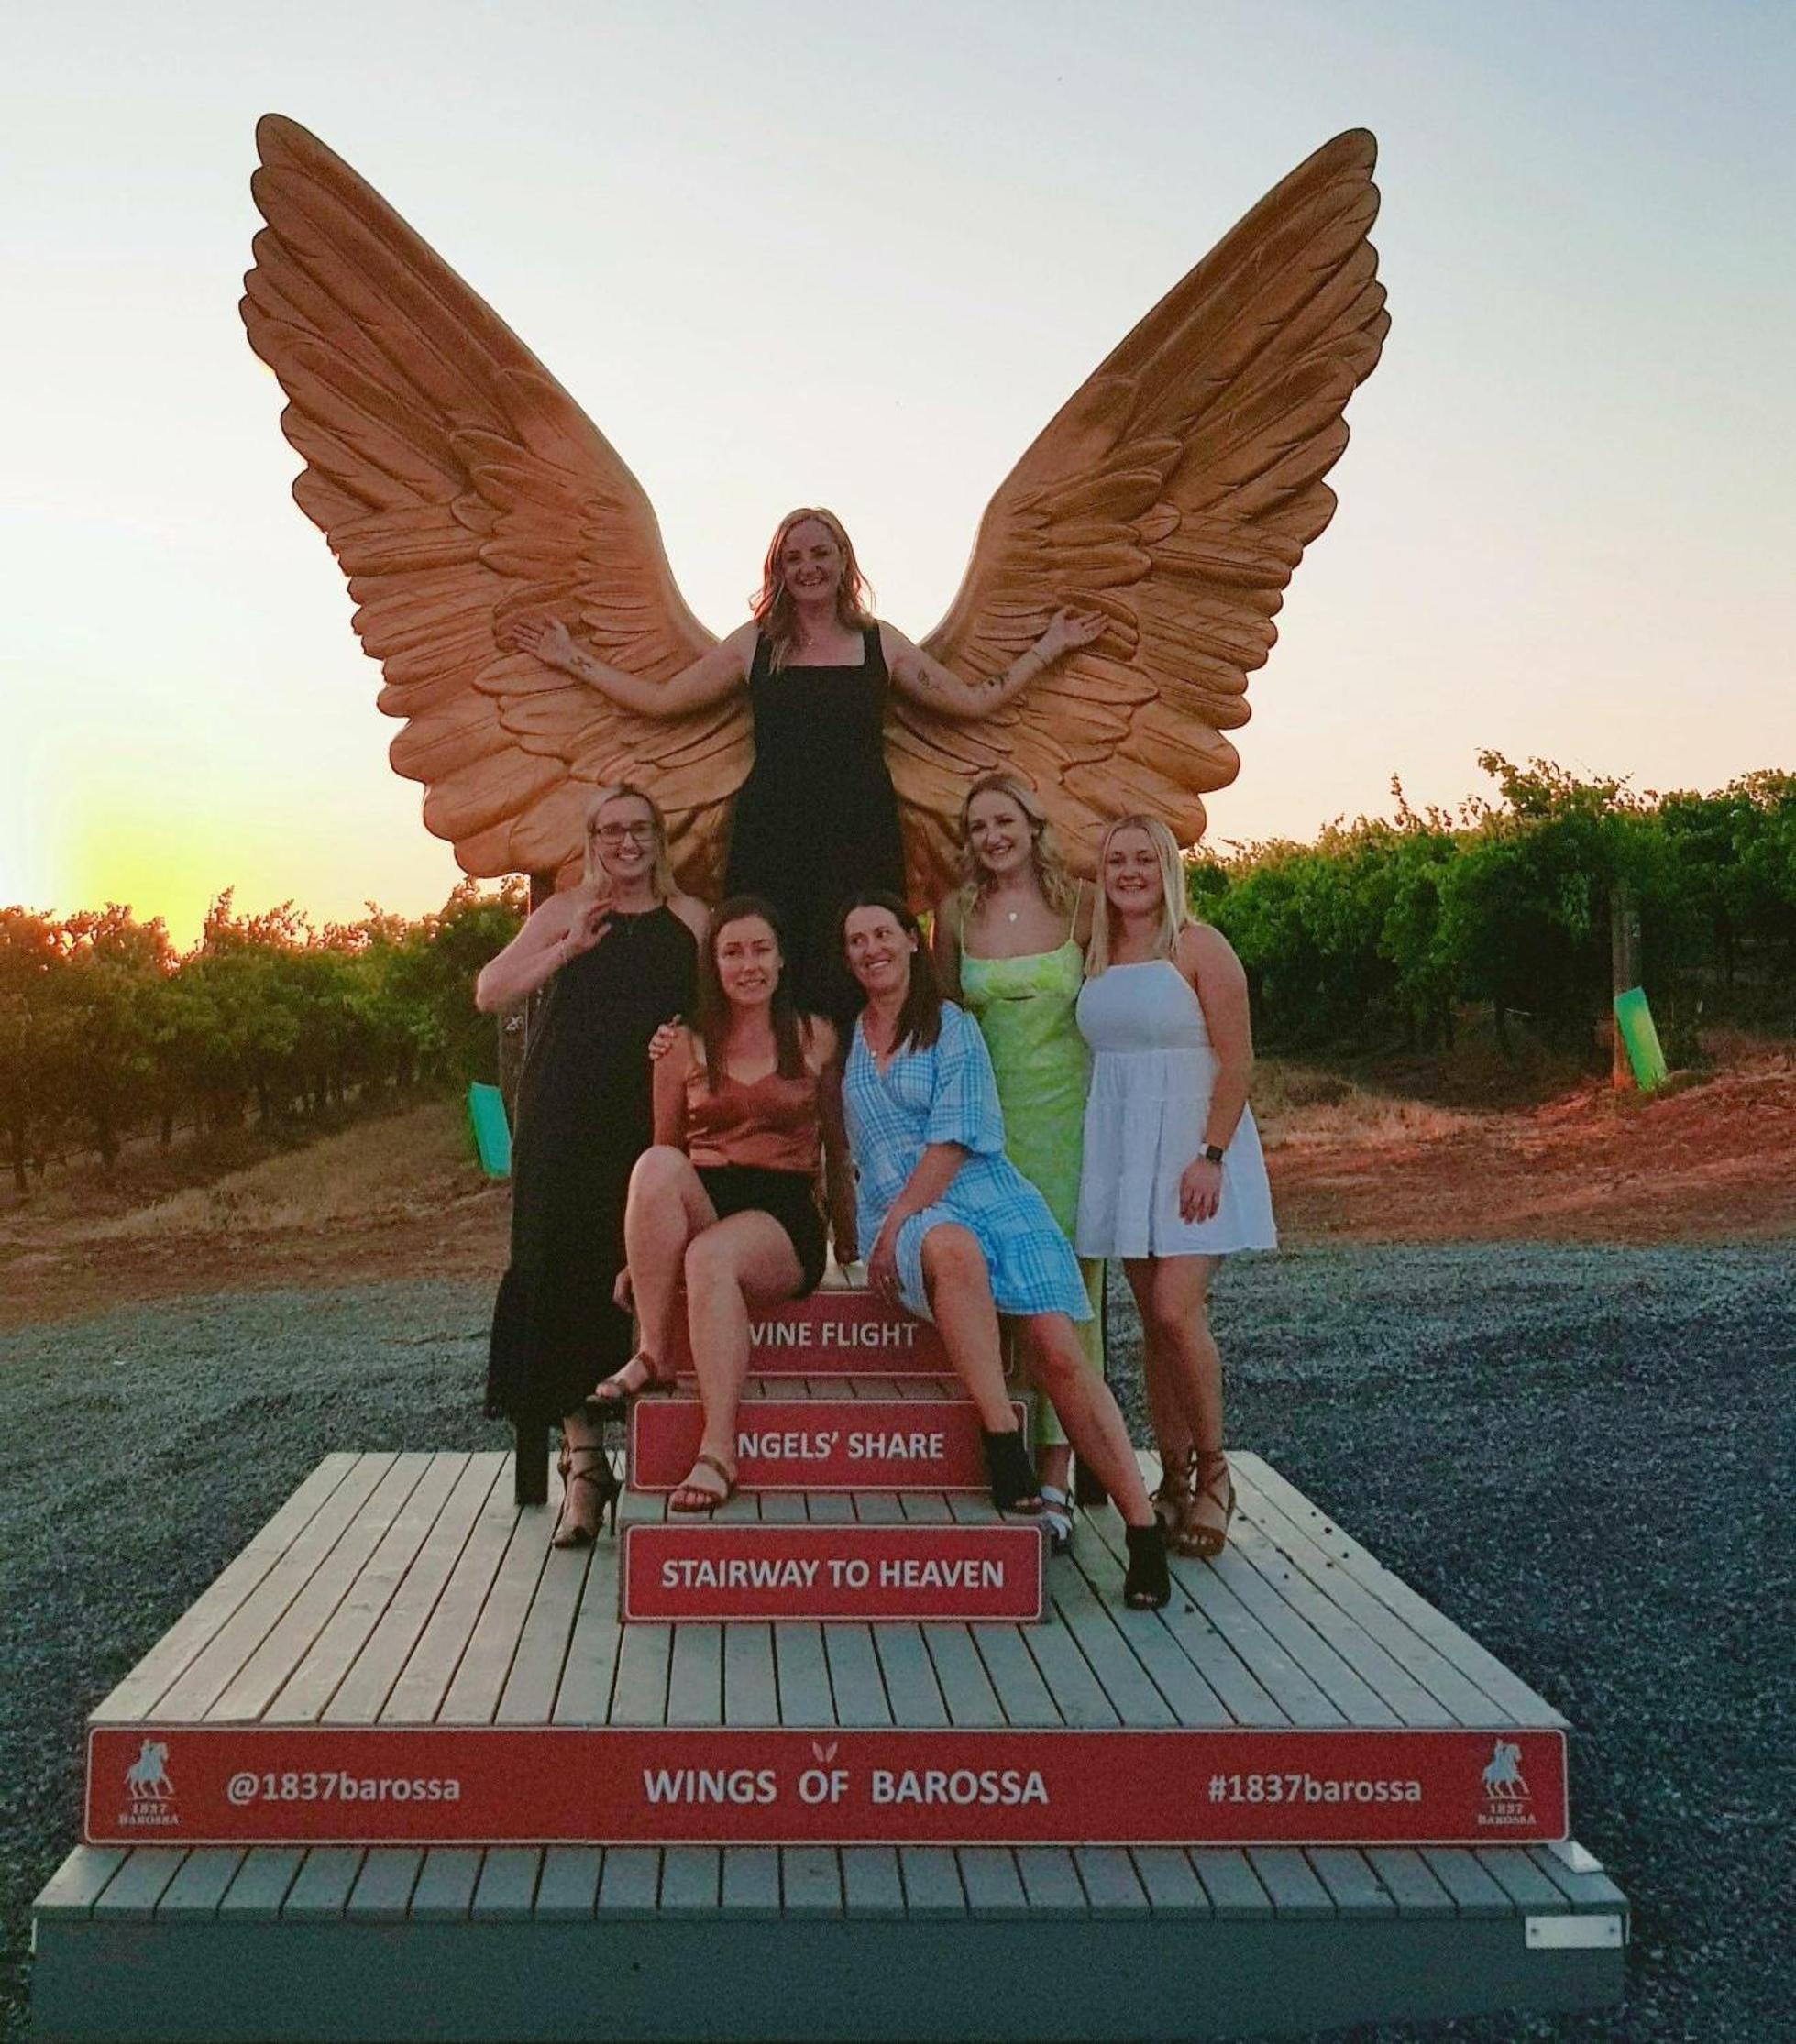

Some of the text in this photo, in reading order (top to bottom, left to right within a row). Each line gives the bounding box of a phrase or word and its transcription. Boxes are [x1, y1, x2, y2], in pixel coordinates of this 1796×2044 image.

[750, 1322, 918, 1347] VINE FLIGHT
[737, 1431, 943, 1459] NGELS' SHARE
[661, 1559, 1004, 1588] STAIRWAY TO HEAVEN
[226, 1771, 460, 1806] @1837barossa
[643, 1769, 1050, 1804] WINGS OF BAROSSA
[1207, 1773, 1423, 1803] #1837barossa
